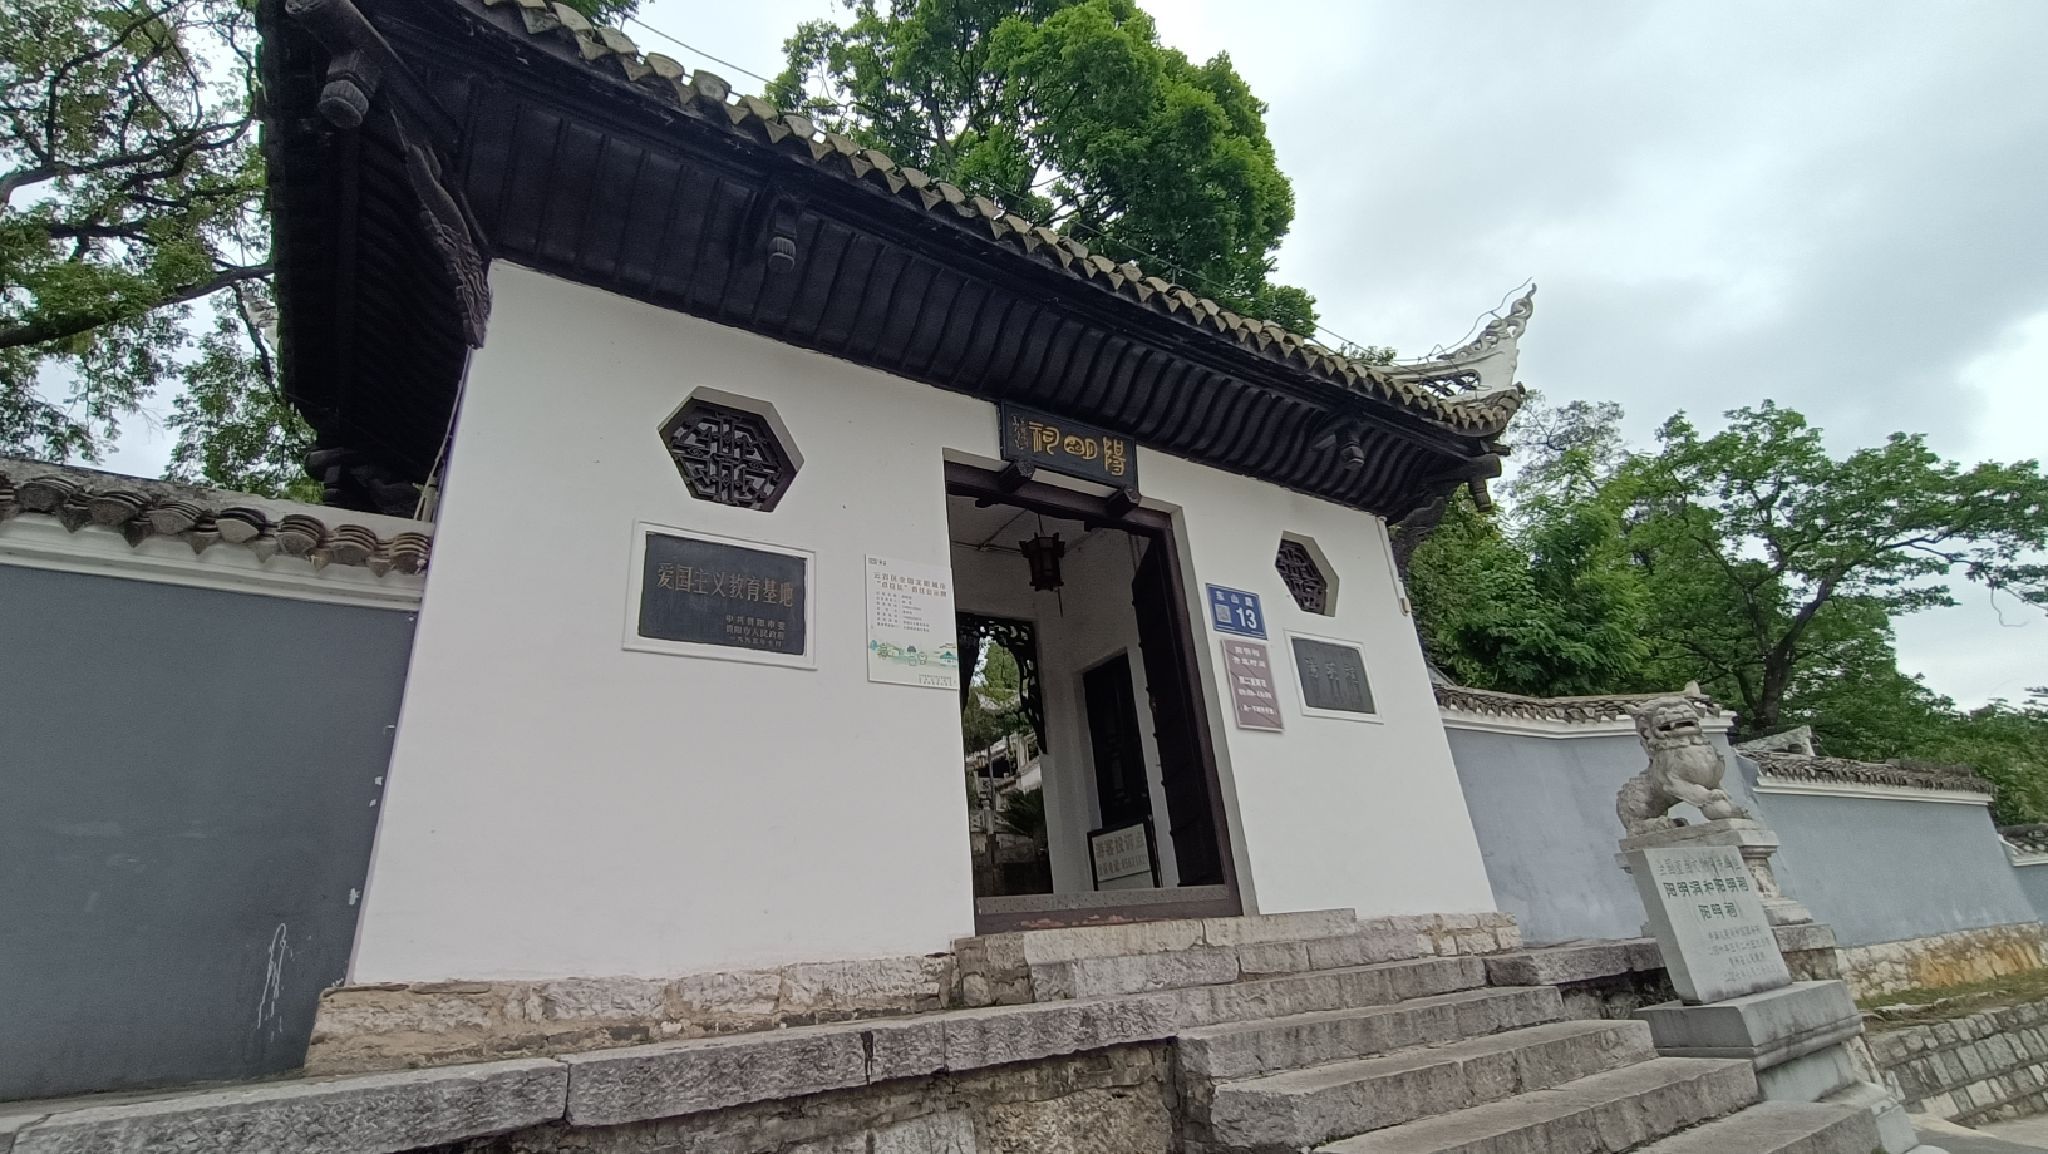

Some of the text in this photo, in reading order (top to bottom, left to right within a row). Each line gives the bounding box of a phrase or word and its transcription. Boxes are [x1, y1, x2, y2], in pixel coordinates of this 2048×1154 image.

[656, 561, 793, 608] 爱国主义教育基地
[1236, 607, 1257, 629] 13
[1663, 877, 1749, 899] 阳明洞和阳明祠
